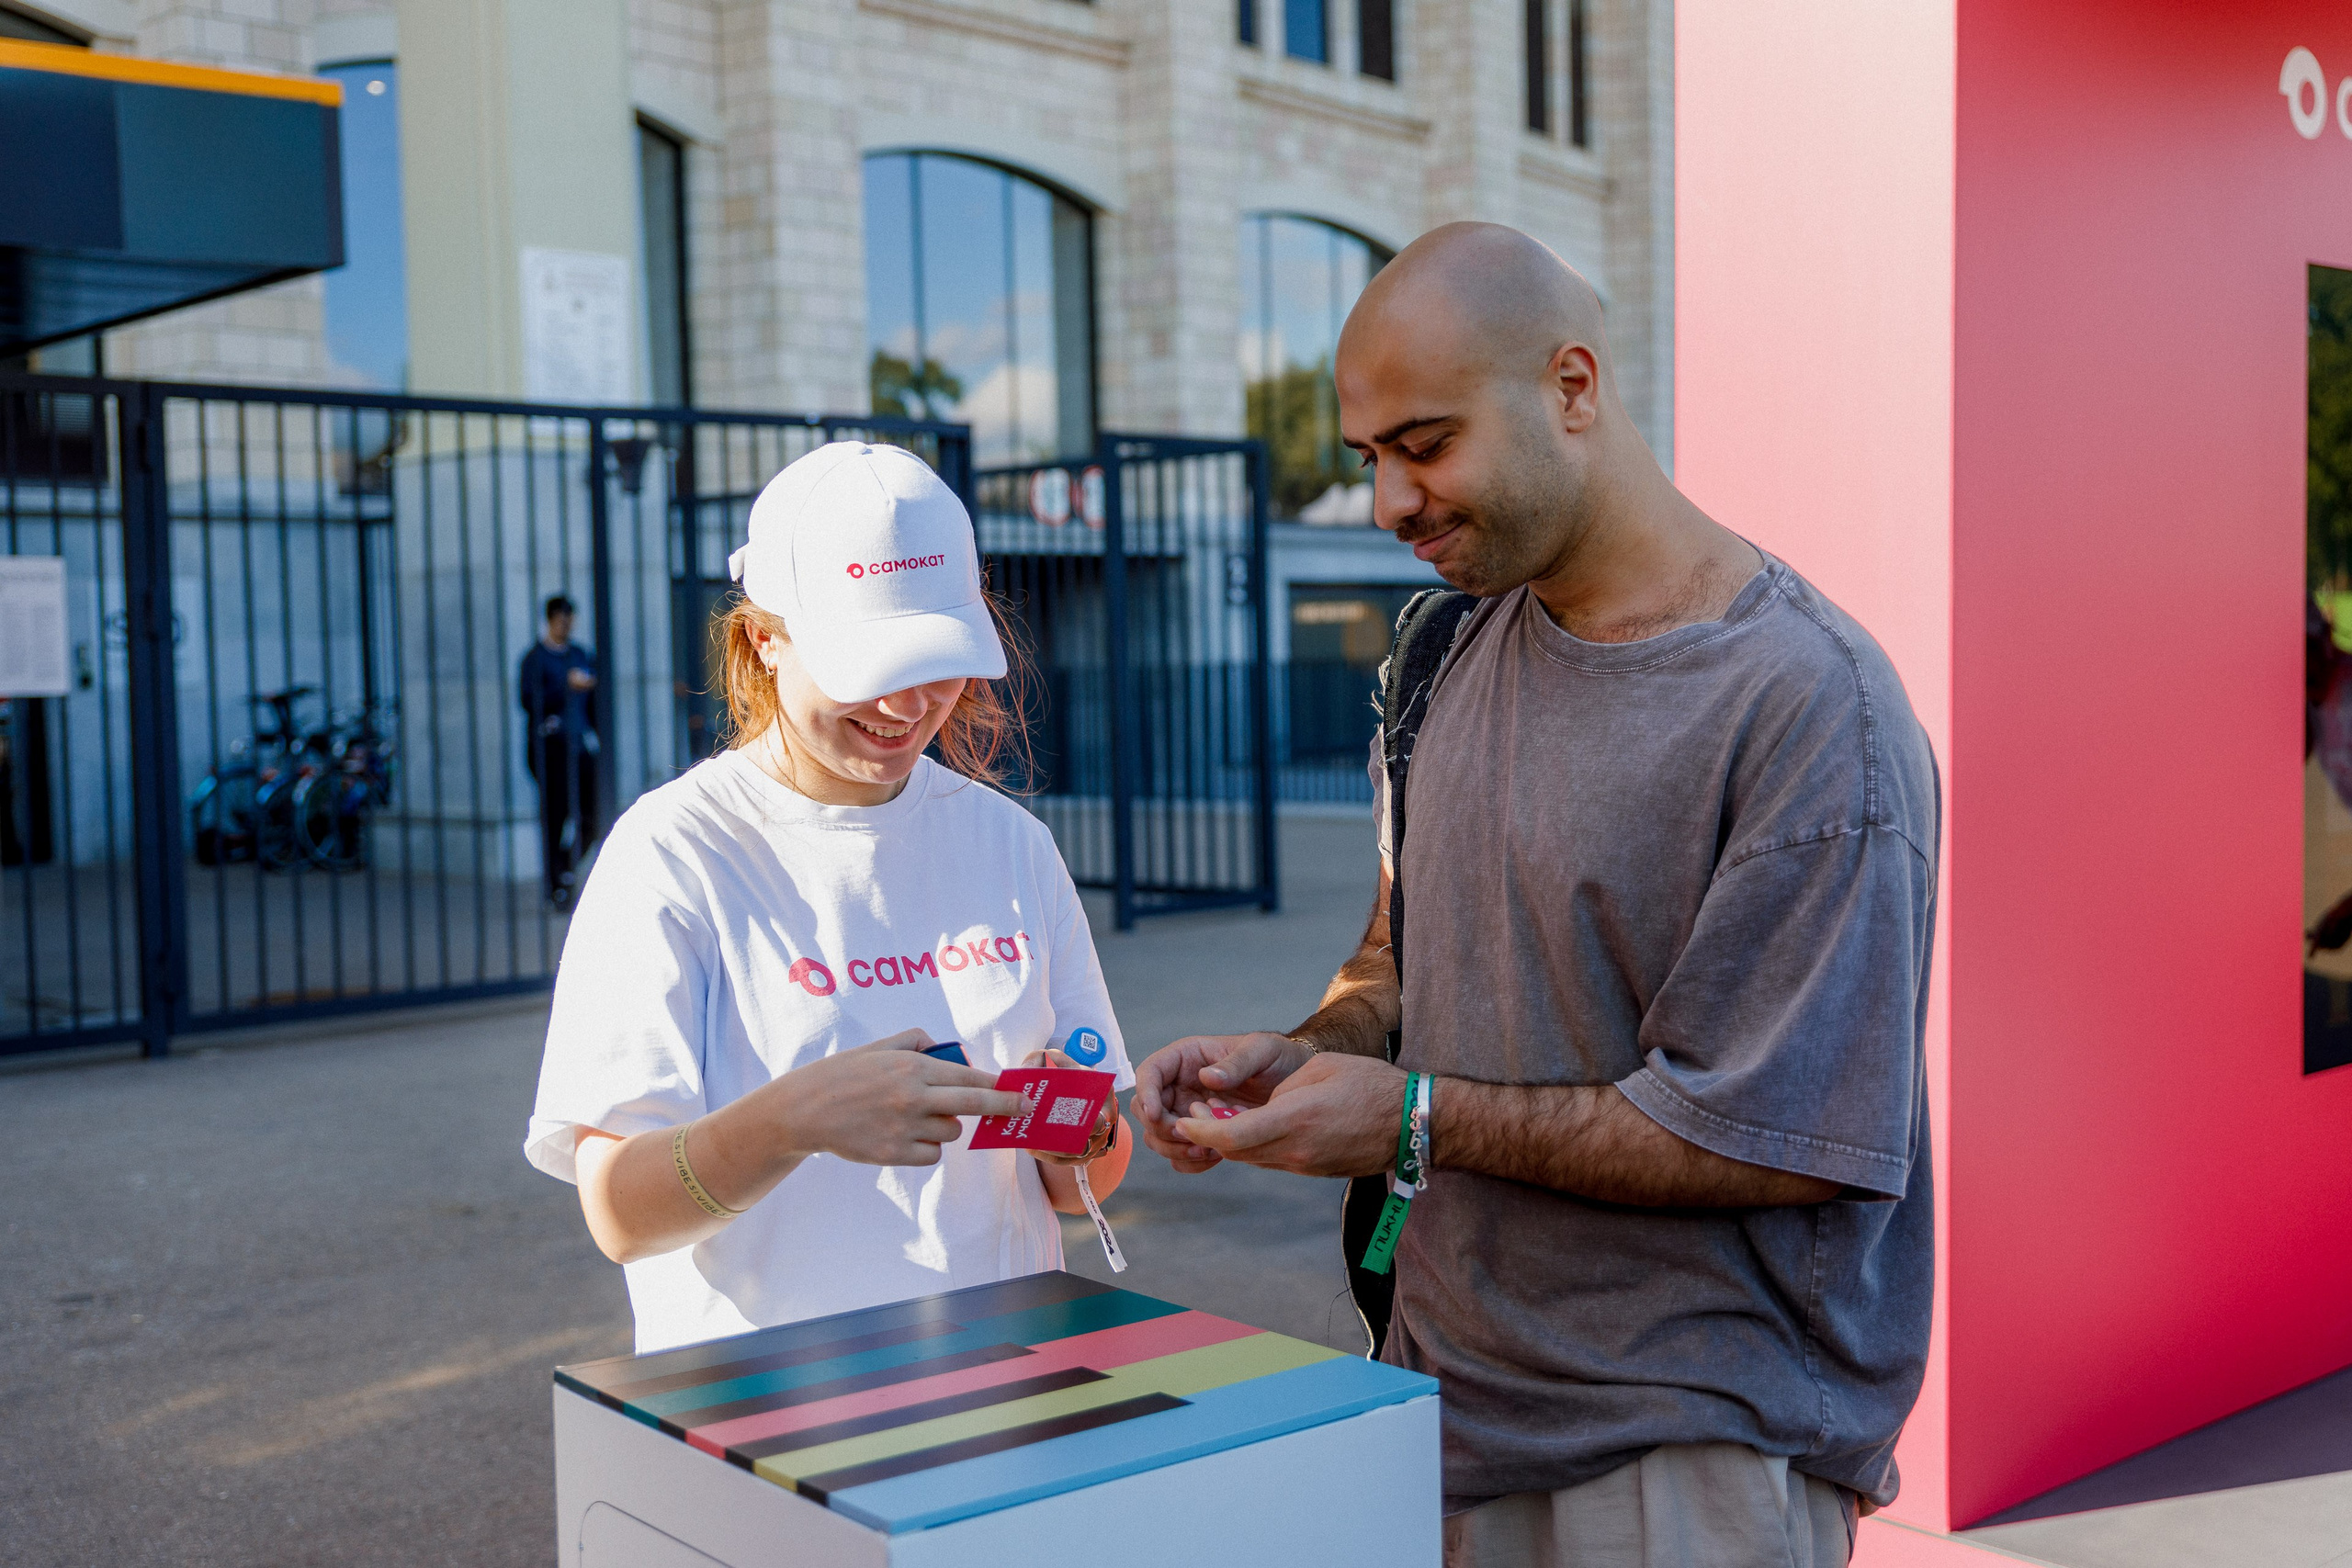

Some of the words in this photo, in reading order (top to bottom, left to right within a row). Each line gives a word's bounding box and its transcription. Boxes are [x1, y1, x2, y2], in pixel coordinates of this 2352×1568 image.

[869, 554, 944, 574] самокат
[1001, 1082, 1034, 1135] Карка
[1015, 1079, 1049, 1139] учасника
